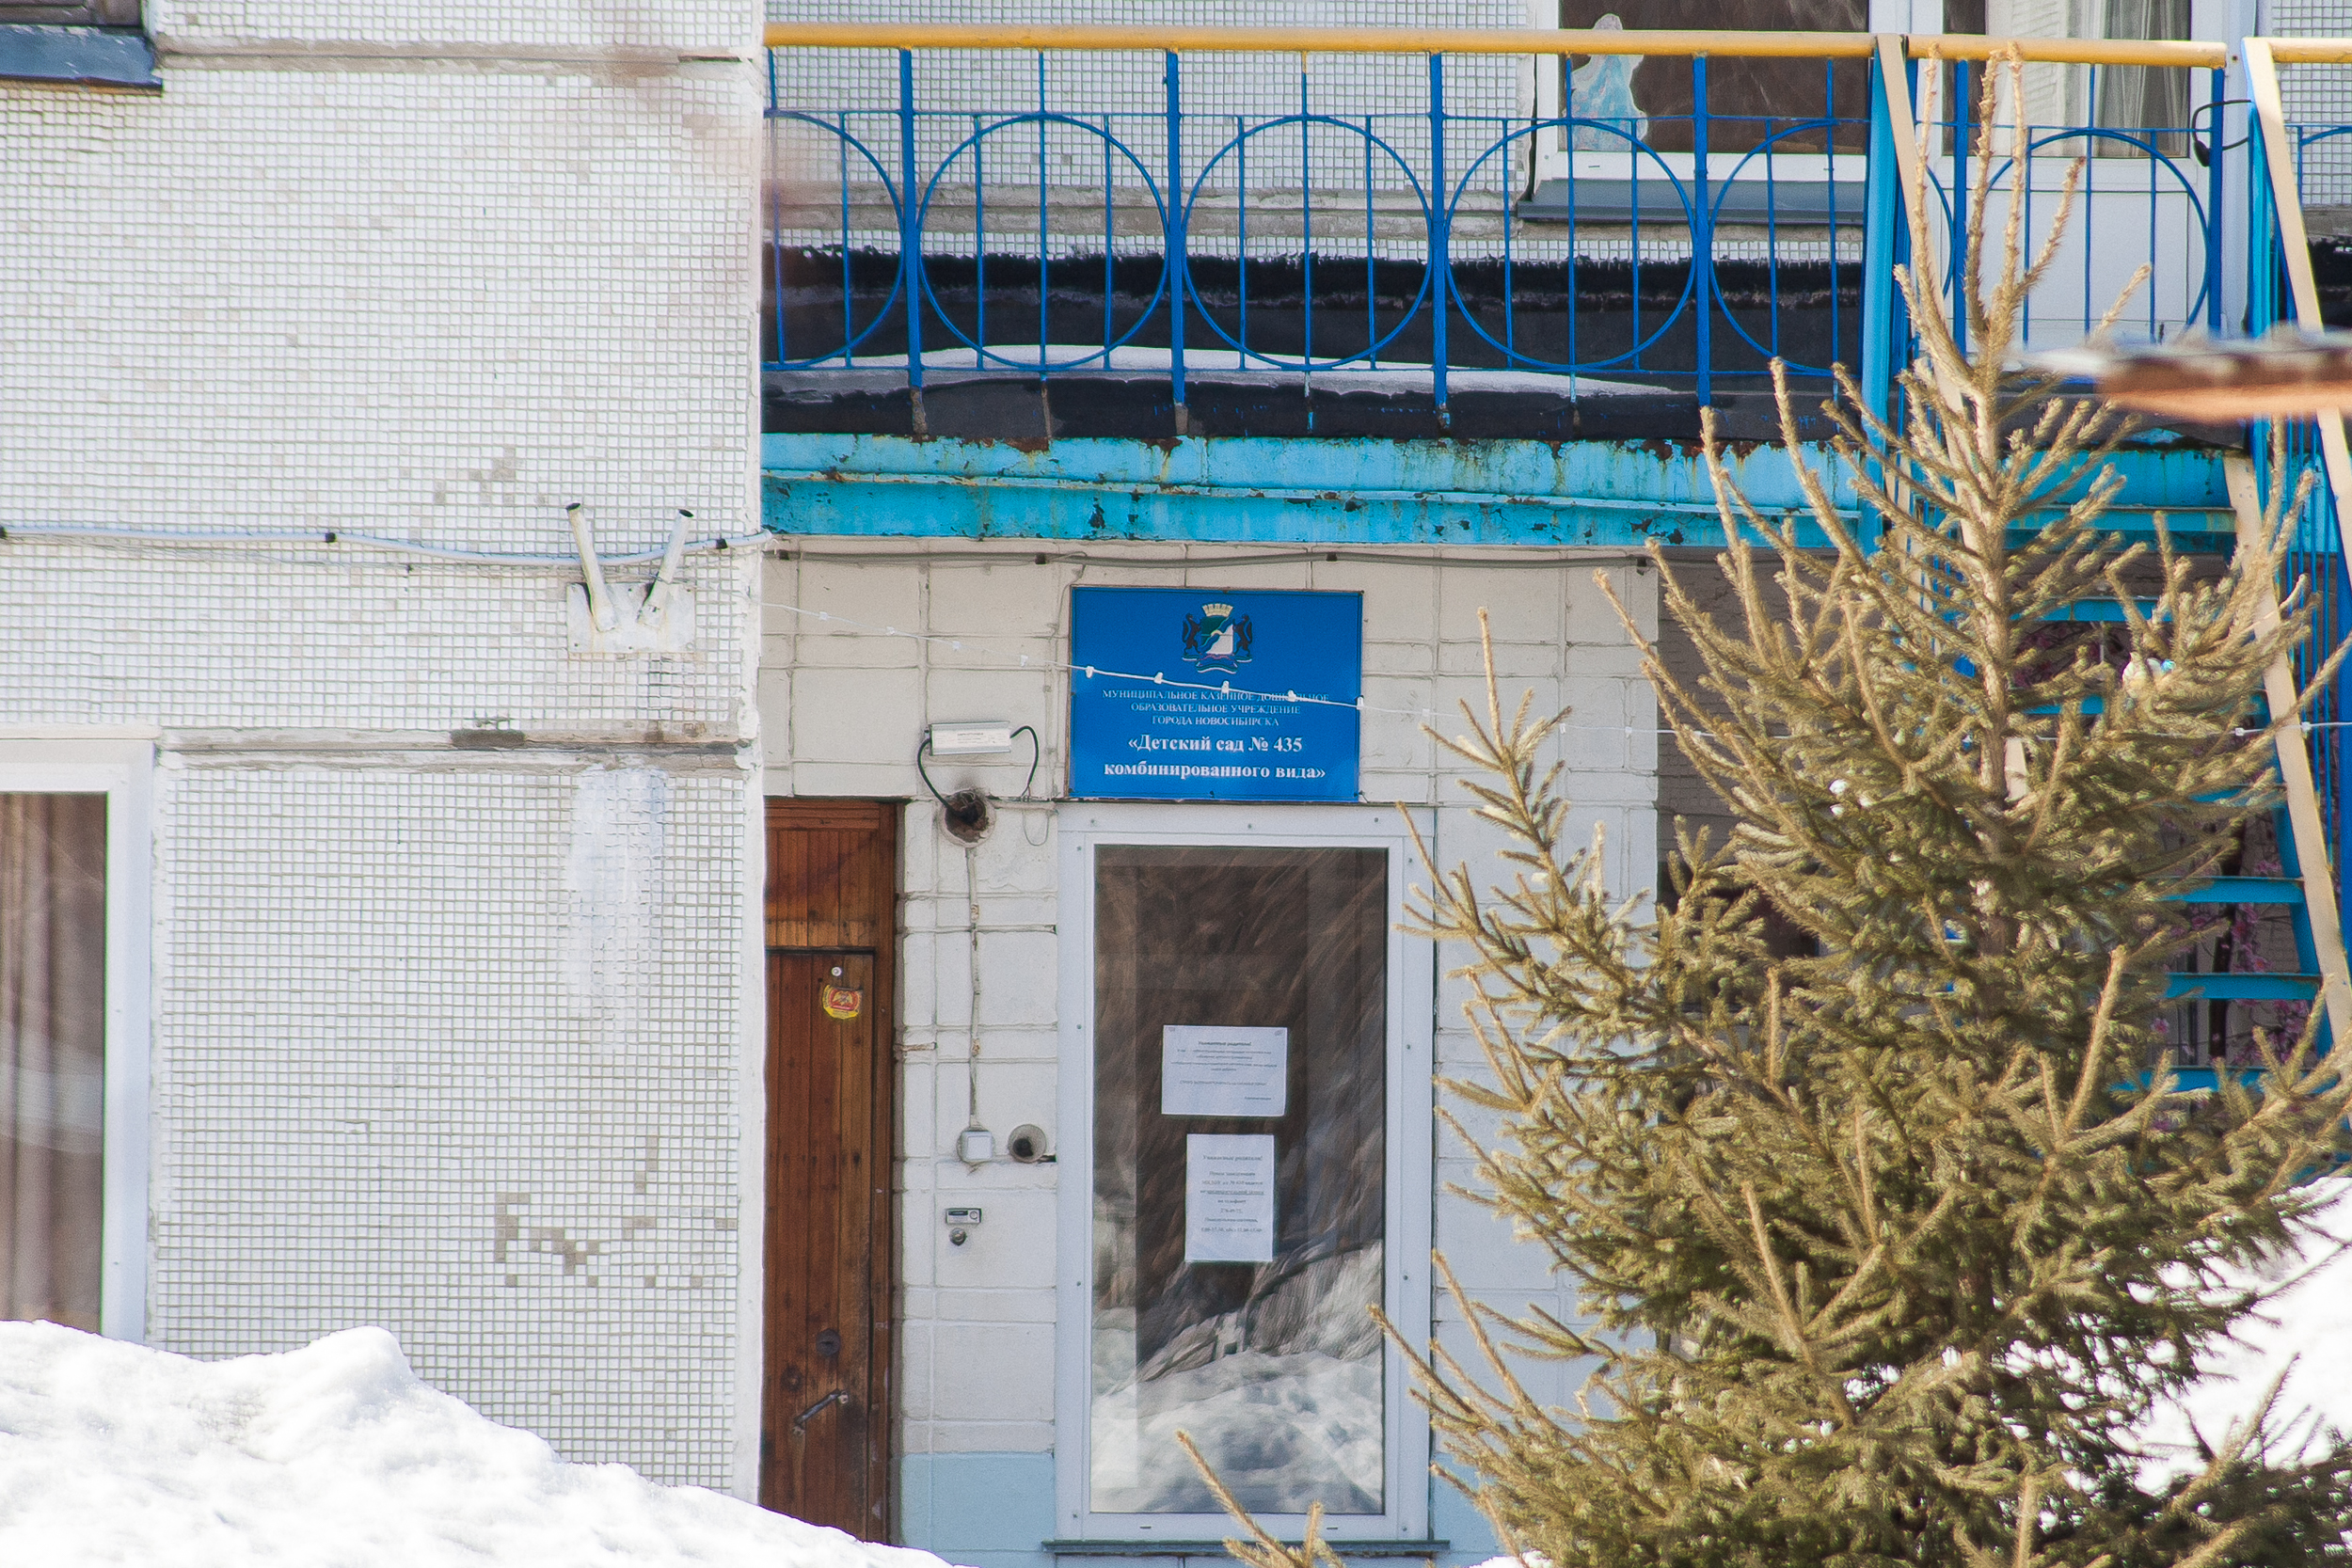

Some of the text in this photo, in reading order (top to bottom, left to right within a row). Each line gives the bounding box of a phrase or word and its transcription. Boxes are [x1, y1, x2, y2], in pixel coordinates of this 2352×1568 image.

[1102, 689, 1329, 703] МУНИЦИПАЛЬНОЕ КАЗЕННОЕ ДОШКЛЬНОЕ
[1131, 703, 1300, 715] ОБРАЗОВАТЕЛЬНОЕ УЧРЕЖДЕНИЕ
[1152, 716, 1279, 726] ГОРОДА НОВОСИБИРСКА
[1128, 734, 1303, 752] «Детский сад № 435
[1104, 761, 1326, 780] комбинированного вида»
